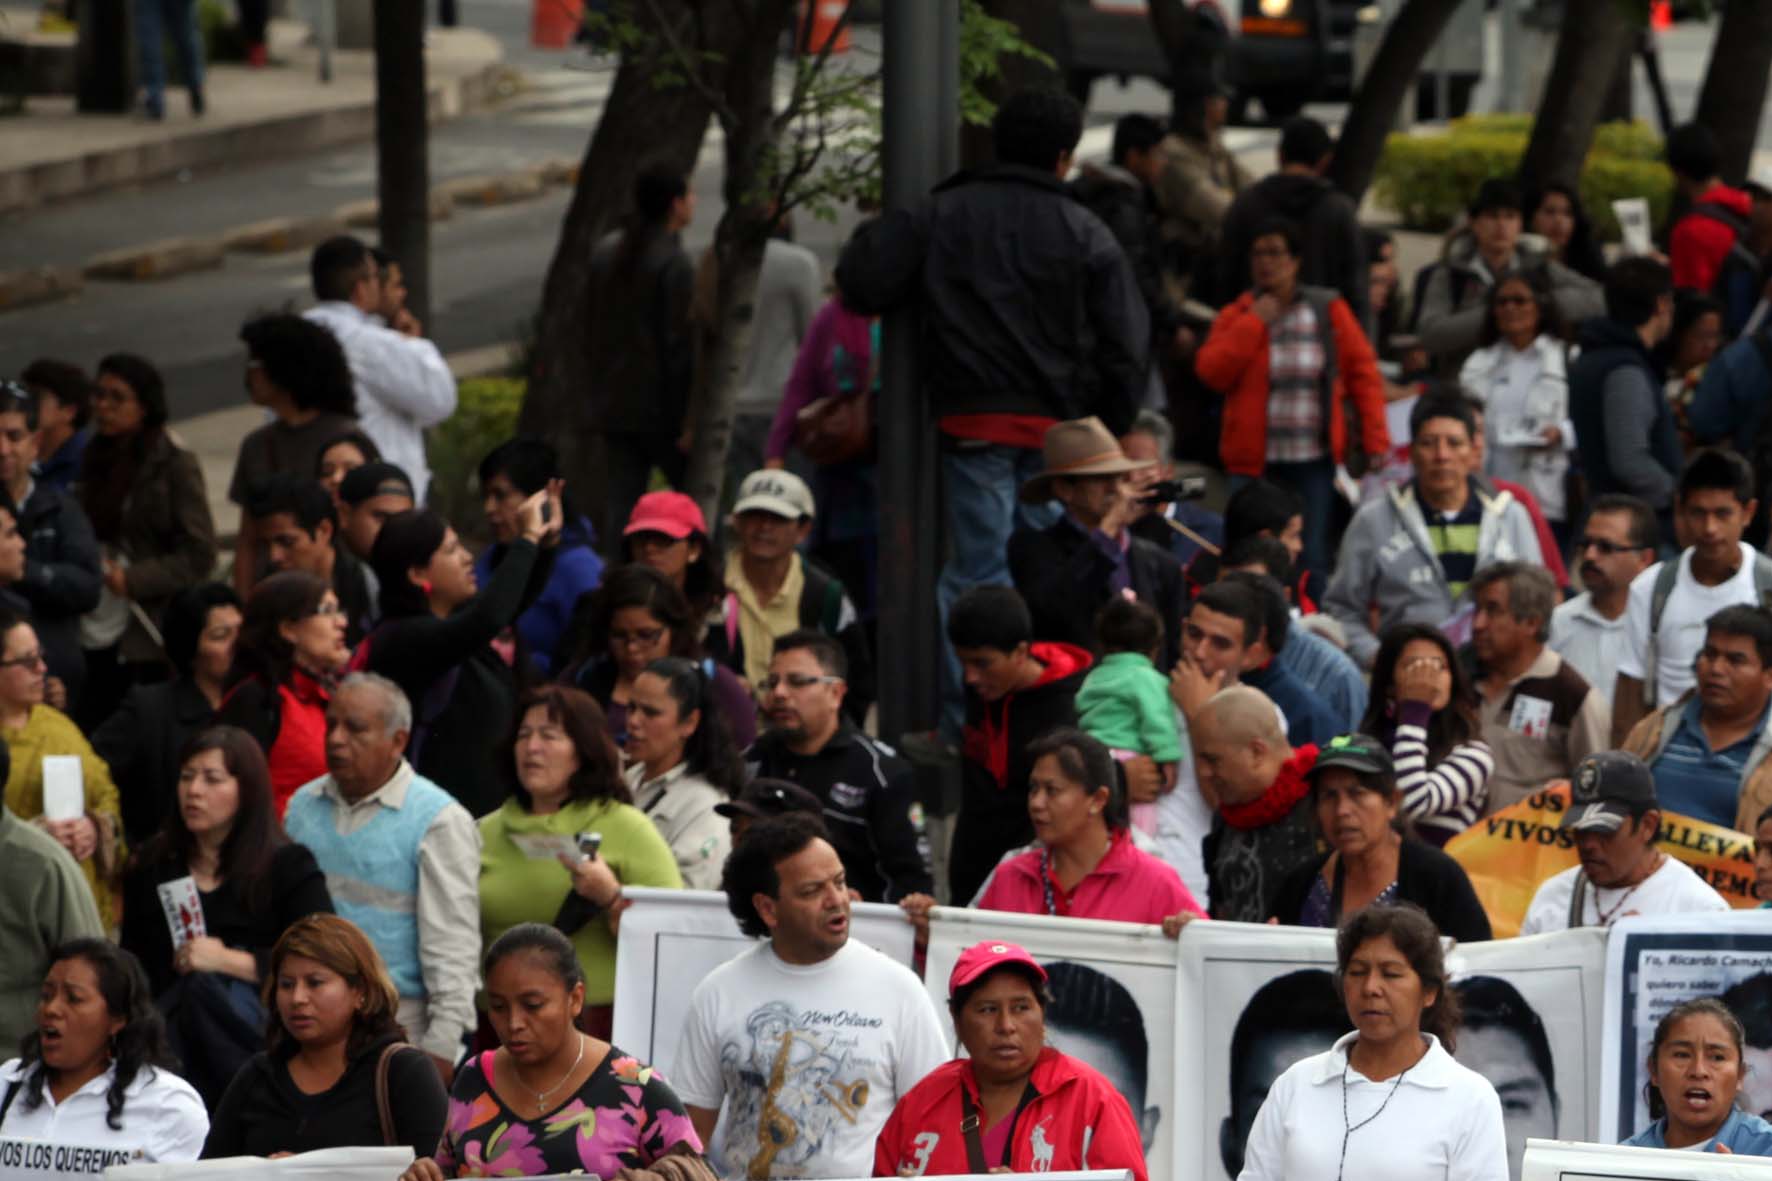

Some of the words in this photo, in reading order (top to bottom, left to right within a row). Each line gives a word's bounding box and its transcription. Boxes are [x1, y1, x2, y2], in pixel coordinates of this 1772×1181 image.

[1668, 955, 1717, 967] Ricardo
[1646, 979, 1686, 990] quiero
[1689, 979, 1720, 990] saber
[25, 1144, 52, 1170] LOS
